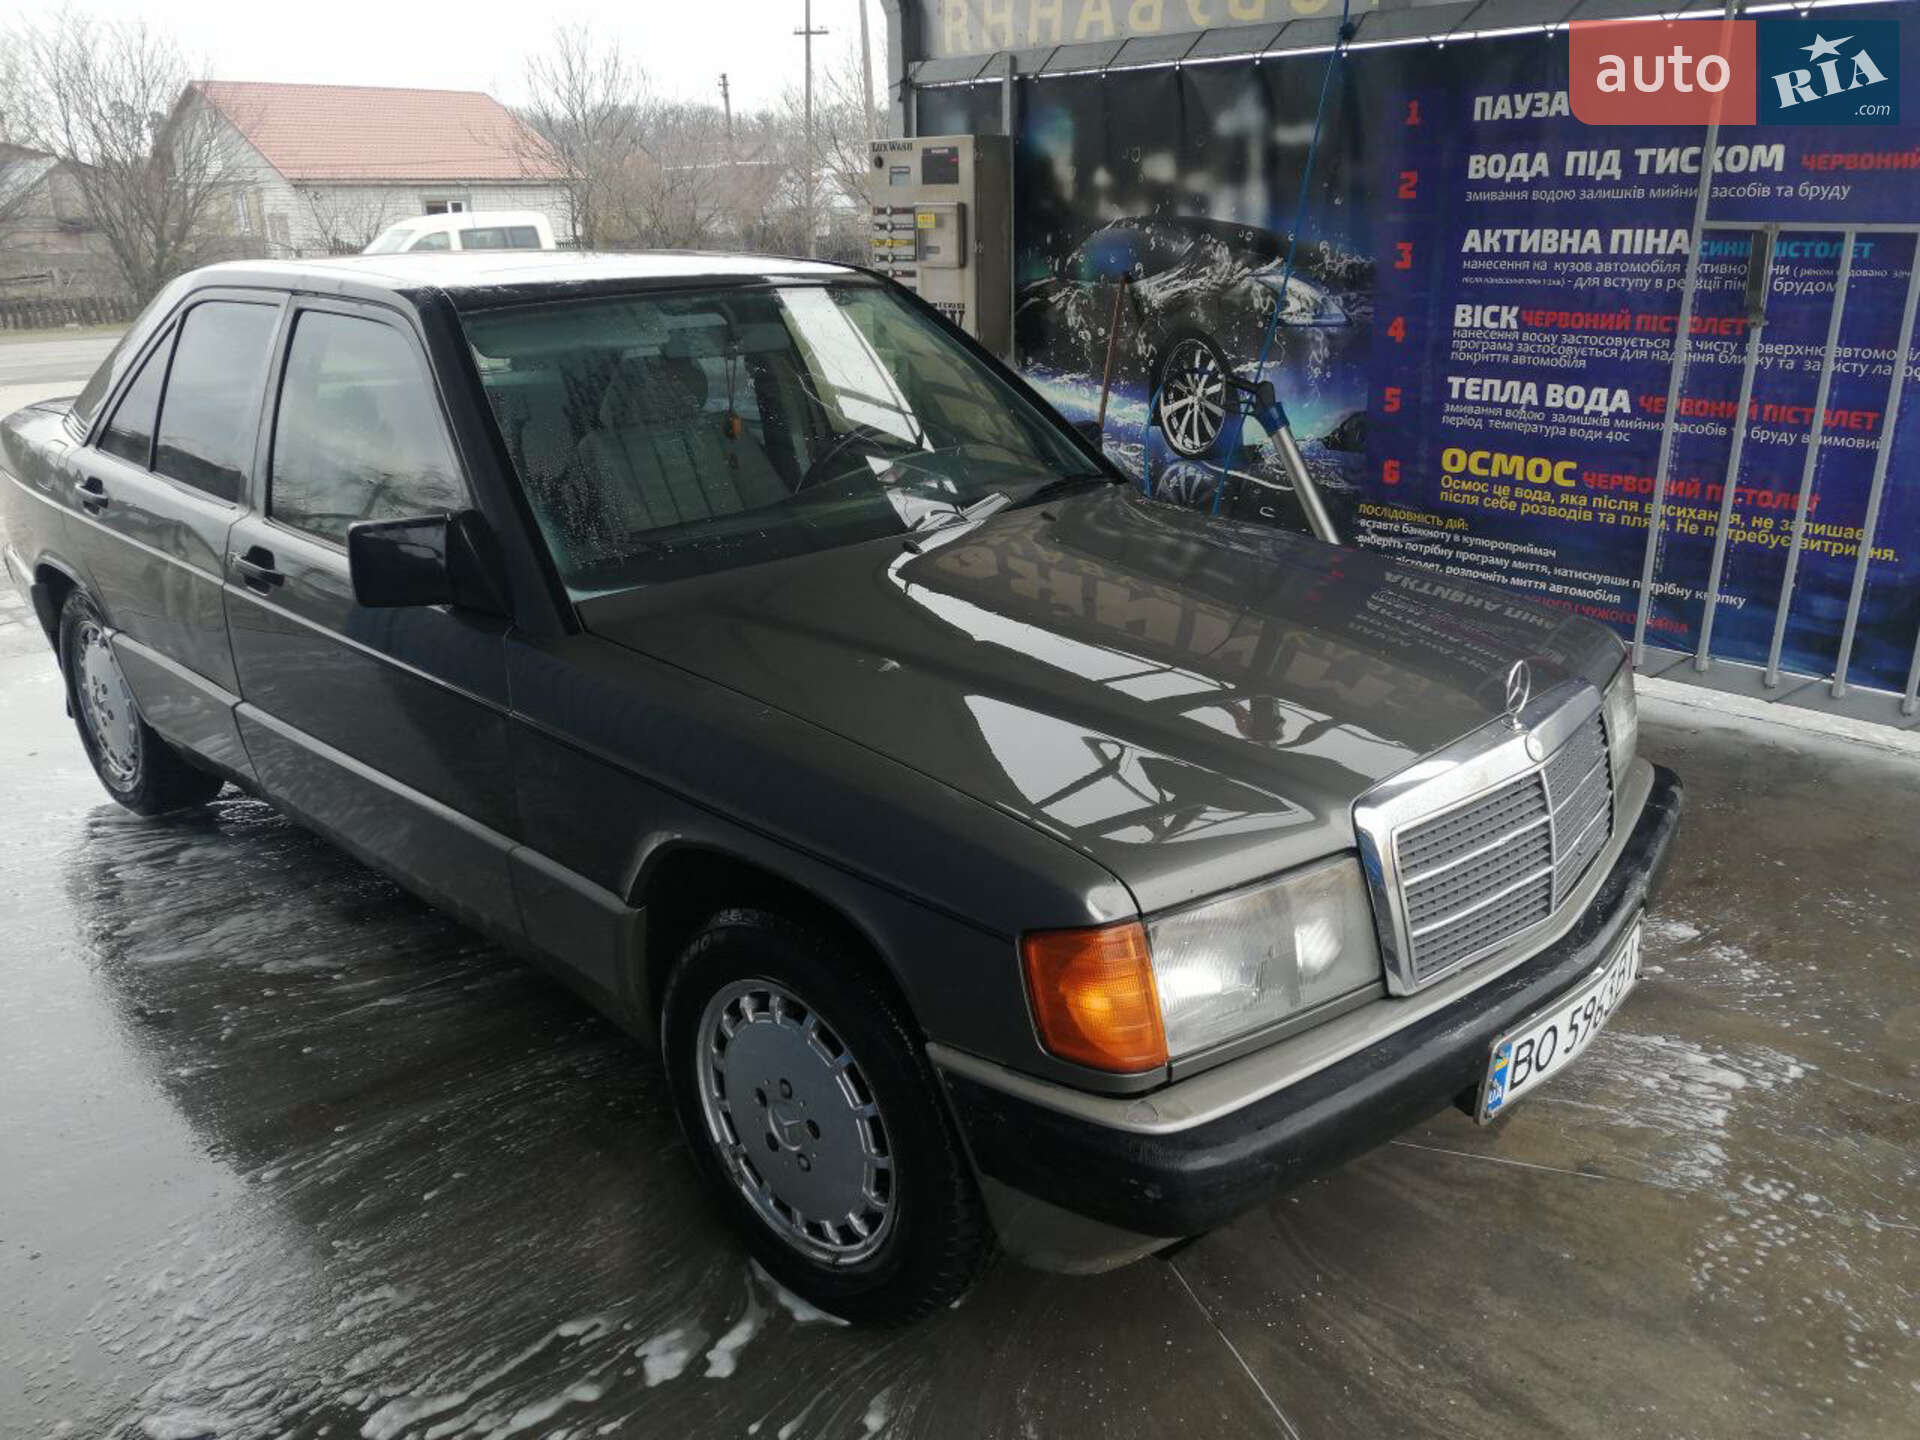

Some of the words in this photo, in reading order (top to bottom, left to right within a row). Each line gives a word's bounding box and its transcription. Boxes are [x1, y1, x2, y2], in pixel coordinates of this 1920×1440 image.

[1405, 100, 1421, 126] 1
[1473, 91, 1570, 121] ПАУЗА
[1467, 152, 1549, 183] ВОДА
[1565, 149, 1622, 181] ПІД
[1398, 171, 1417, 199] 2
[1465, 191, 1528, 202] змивання
[1532, 190, 1575, 204] водою
[1579, 185, 1645, 200] залишків
[1649, 184, 1700, 199] мийни
[1711, 182, 1770, 198] засобів
[1776, 184, 1794, 197] та
[1798, 182, 1851, 200] бруду
[1394, 242, 1413, 269] 3
[1461, 229, 1602, 254] АКТИВНА
[1610, 229, 1690, 254] ПІНА
[1463, 260, 1529, 270] нанесення
[1533, 261, 1547, 270] на
[1554, 262, 1591, 275] кузов
[1596, 259, 1680, 273] автомобіля
[1574, 277, 1600, 289] для
[1604, 278, 1651, 292] вступу
[1655, 280, 1663, 289] в
[1387, 315, 1405, 343] 4
[1455, 304, 1519, 329] ВІСК
[1522, 308, 1631, 331] ЧЕРВОНИЙ
[1452, 340, 1513, 355] програма
[1517, 343, 1618, 359] застосовується
[1620, 348, 1648, 361] для
[1778, 357, 1795, 370] та
[1453, 329, 1519, 340] нанесення
[1522, 333, 1558, 344] воску
[1561, 334, 1670, 349] застосовується
[1696, 339, 1737, 353] чисту
[1450, 351, 1509, 365] покриття
[1511, 354, 1586, 369] автомобіля
[1383, 387, 1402, 413] 5
[1448, 376, 1539, 405] ТЕПЛА
[1545, 384, 1632, 416] ВОДА
[1441, 414, 1483, 429] період
[1488, 419, 1566, 438] температура
[1570, 430, 1603, 441] води
[1443, 403, 1502, 417] змивання
[1505, 408, 1545, 421] водою
[1552, 412, 1610, 427] залишків
[1751, 426, 1798, 446] бруду
[1382, 459, 1400, 485] 6
[1441, 448, 1577, 487] ОСМОС
[1440, 475, 1489, 493] Осмос
[1492, 484, 1511, 498] це
[1514, 487, 1555, 504] вода,
[1560, 493, 1587, 507] яка
[1592, 495, 1638, 512] після
[1752, 516, 1774, 530] не
[1440, 490, 1479, 506] після
[1482, 495, 1518, 511] себе
[1520, 502, 1592, 523] розводів
[1598, 512, 1616, 525] та
[1676, 518, 1699, 535] Не
[1402, 523, 1451, 543] банкноту
[1462, 534, 1557, 558] купюроприймач
[1405, 541, 1454, 560] потрібну
[1456, 550, 1509, 569] програму
[1511, 560, 1551, 576] миття,
[1554, 567, 1630, 588] натиснувши
[1510, 576, 1547, 591] миття
[1549, 583, 1621, 604] автомобіля
